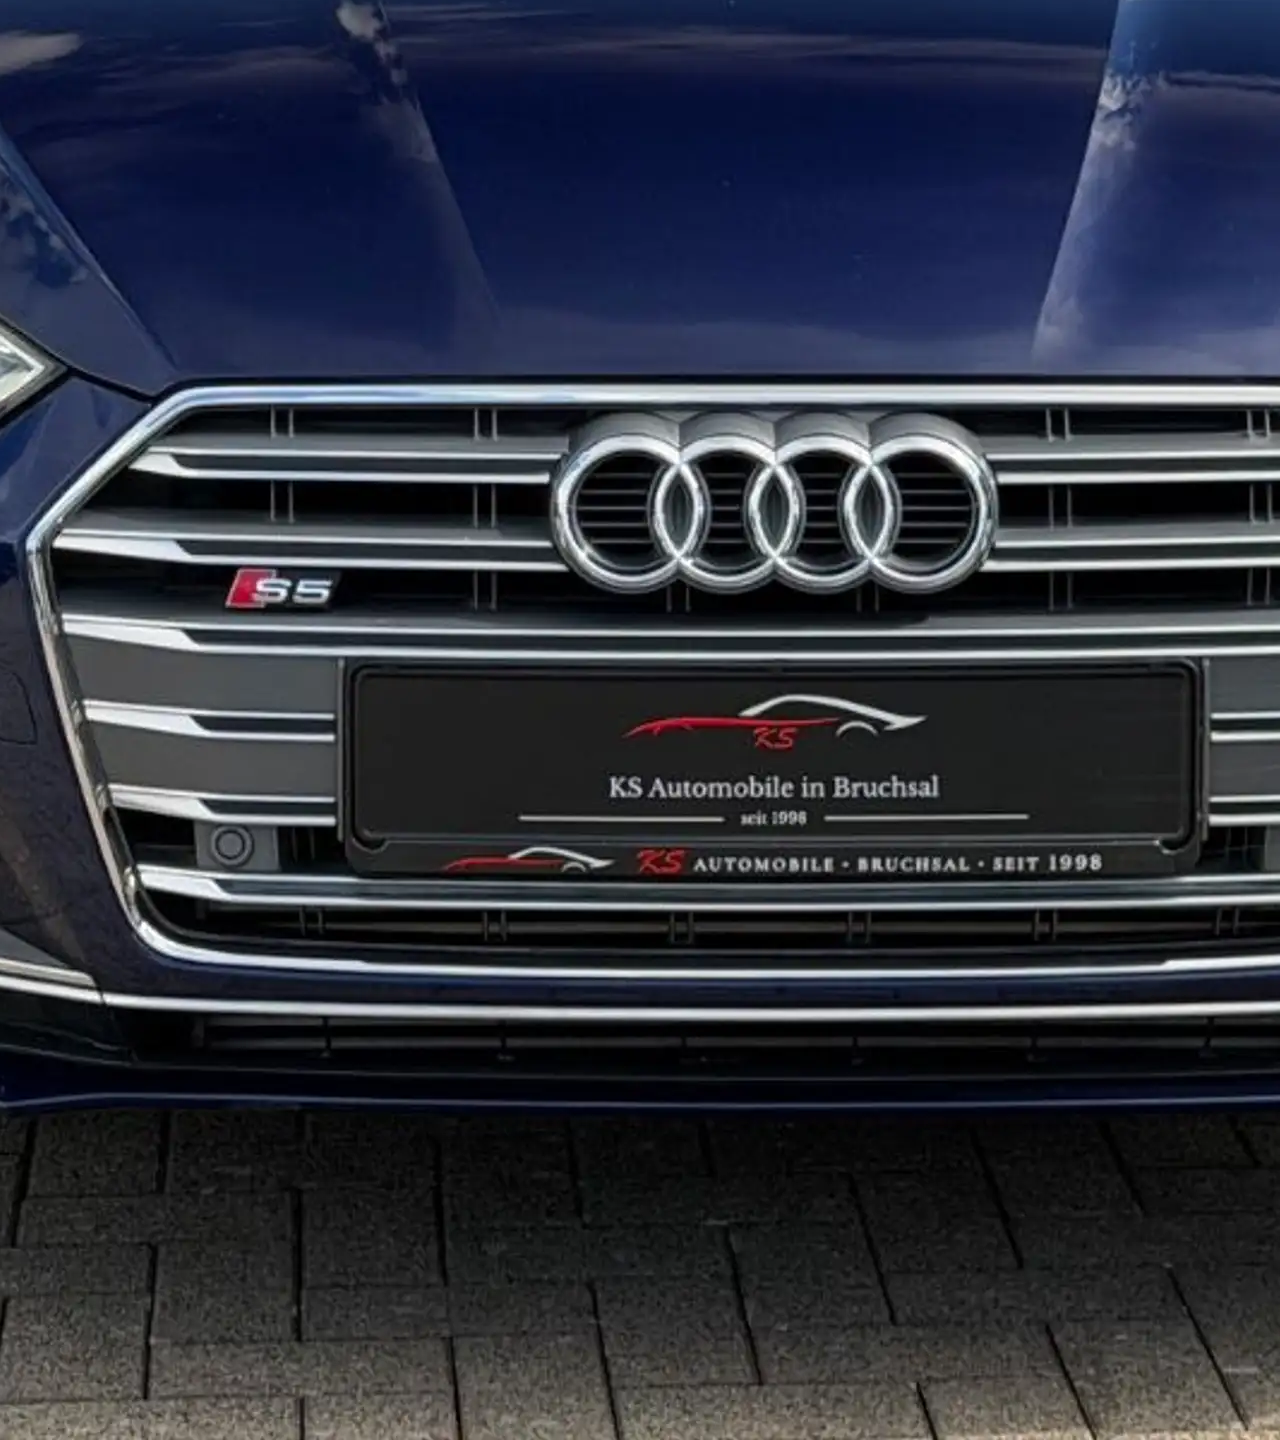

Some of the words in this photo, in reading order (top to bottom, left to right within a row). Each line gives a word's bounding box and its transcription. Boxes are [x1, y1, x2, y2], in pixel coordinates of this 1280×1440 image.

[252, 577, 333, 604] S5
[753, 727, 798, 750] KS
[609, 775, 643, 799] KS
[647, 775, 795, 799] Automobile
[801, 775, 826, 799] in
[832, 774, 940, 799] Bruchsal
[740, 810, 768, 826] seit
[771, 810, 807, 826] 1998
[637, 848, 685, 875] KS
[693, 856, 834, 873] AUTOMOBILE
[857, 856, 971, 873] BRUCHSAL
[992, 856, 1040, 872] SEIT
[1049, 853, 1103, 872] 1998
